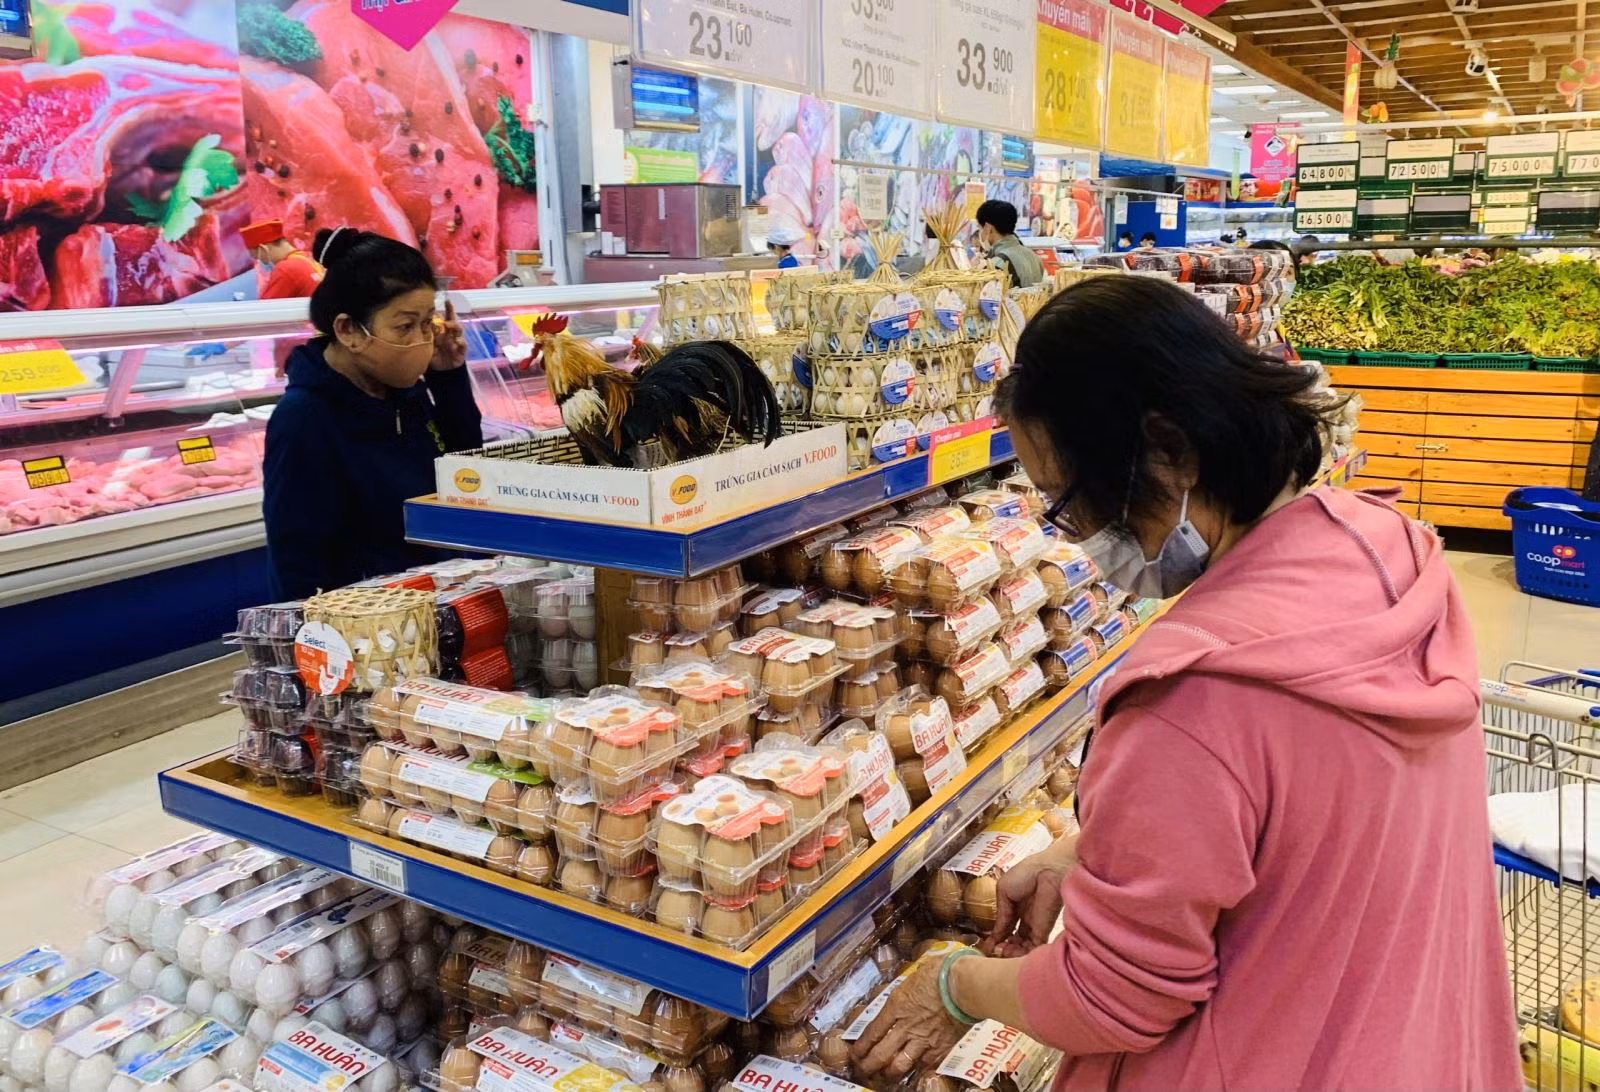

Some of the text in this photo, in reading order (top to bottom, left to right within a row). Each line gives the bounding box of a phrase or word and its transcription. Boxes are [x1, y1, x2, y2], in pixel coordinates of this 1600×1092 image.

[715, 474, 745, 492] TRỨNG
[746, 470, 761, 482] GIA
[782, 457, 802, 473] SẠCH
[804, 445, 837, 465] V.FOOD
[497, 484, 528, 497] TRỨNG
[530, 489, 547, 499] GIA
[573, 493, 599, 504] SẠCH
[603, 495, 640, 507] V.FOOD
[915, 730, 930, 748] BA
[967, 835, 1012, 872] BA HUÂN
[470, 943, 490, 958] BA
[288, 1030, 366, 1076] BA HUÂN
[475, 1036, 501, 1053] BA
[502, 1046, 559, 1079] HUÂN
[739, 1069, 773, 1089] BA
[965, 1059, 993, 1082] BA
